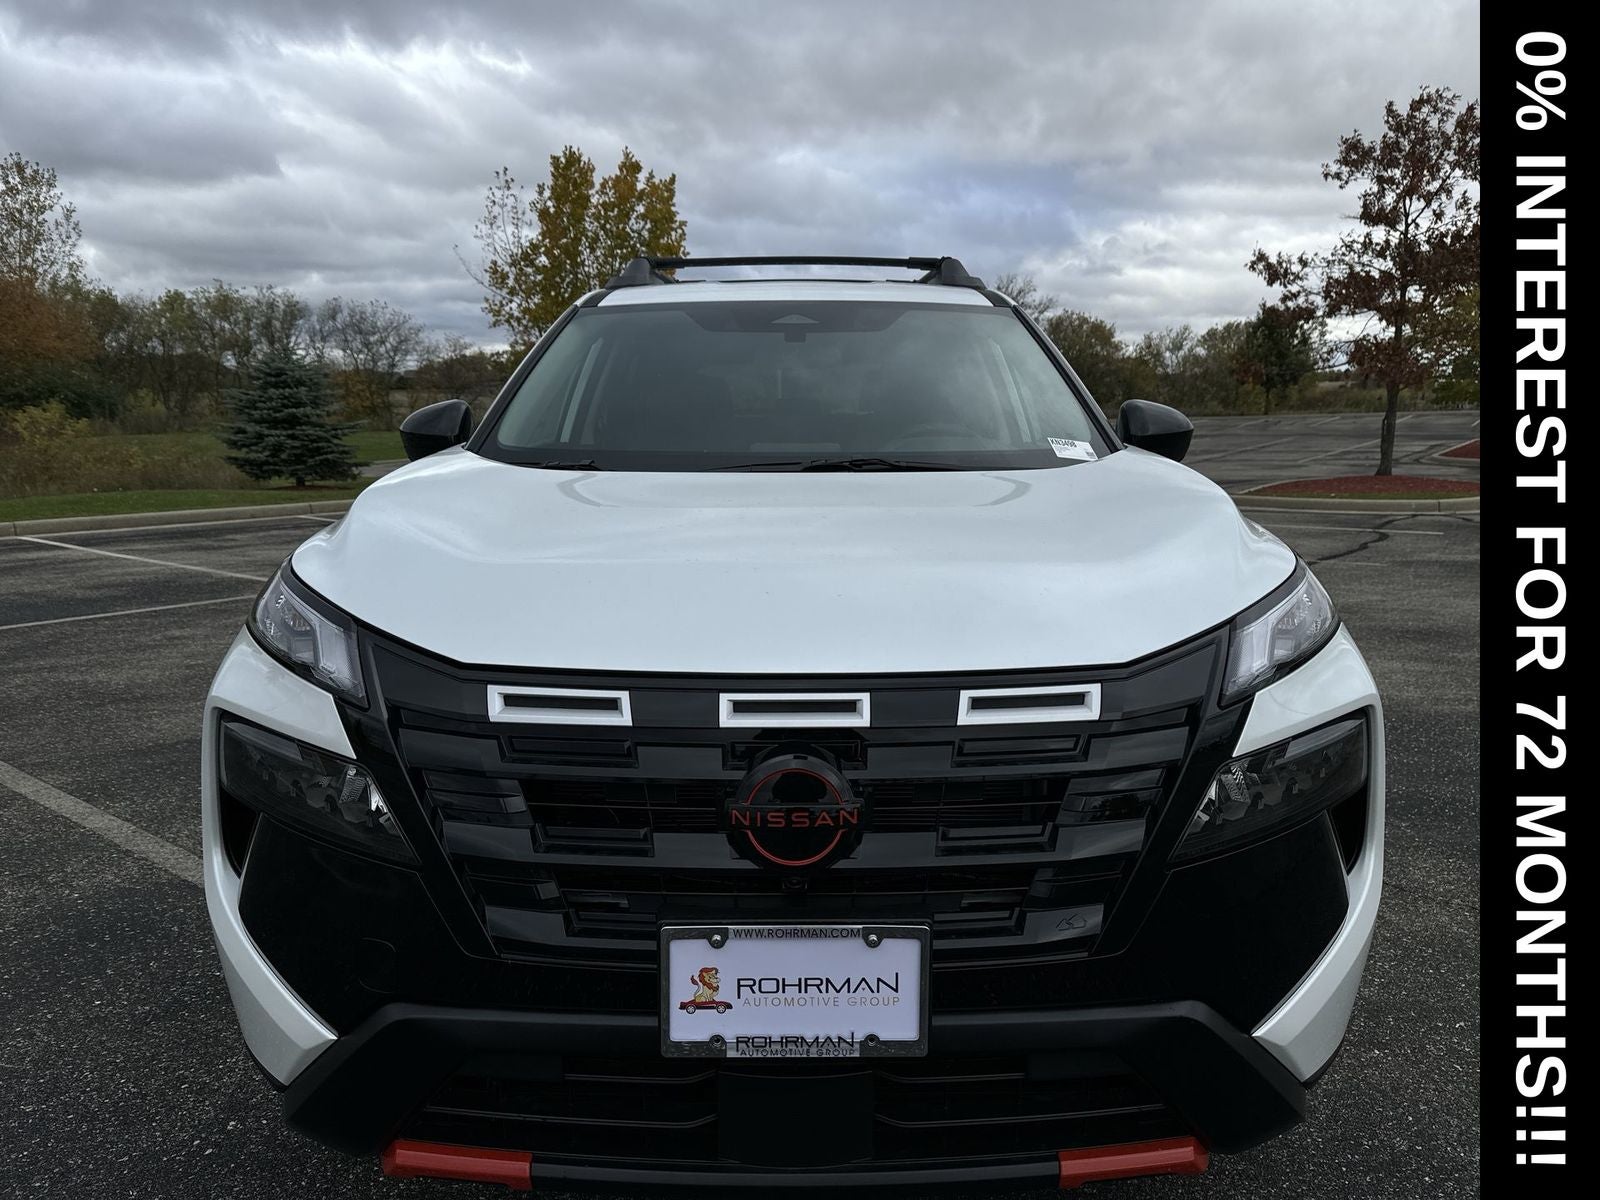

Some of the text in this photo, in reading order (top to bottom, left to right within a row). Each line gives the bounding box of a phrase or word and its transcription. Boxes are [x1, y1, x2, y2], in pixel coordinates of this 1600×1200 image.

[731, 808, 858, 828] NISSAN
[733, 928, 861, 939] WWW.ROHRMAN.COM
[737, 972, 899, 999] ROHRMAN
[743, 996, 901, 1007] AUTOMOTIVE GROUP
[736, 1031, 855, 1052] ROHRMAN
[739, 1048, 856, 1057] AUTOMOTIVE GROUP
